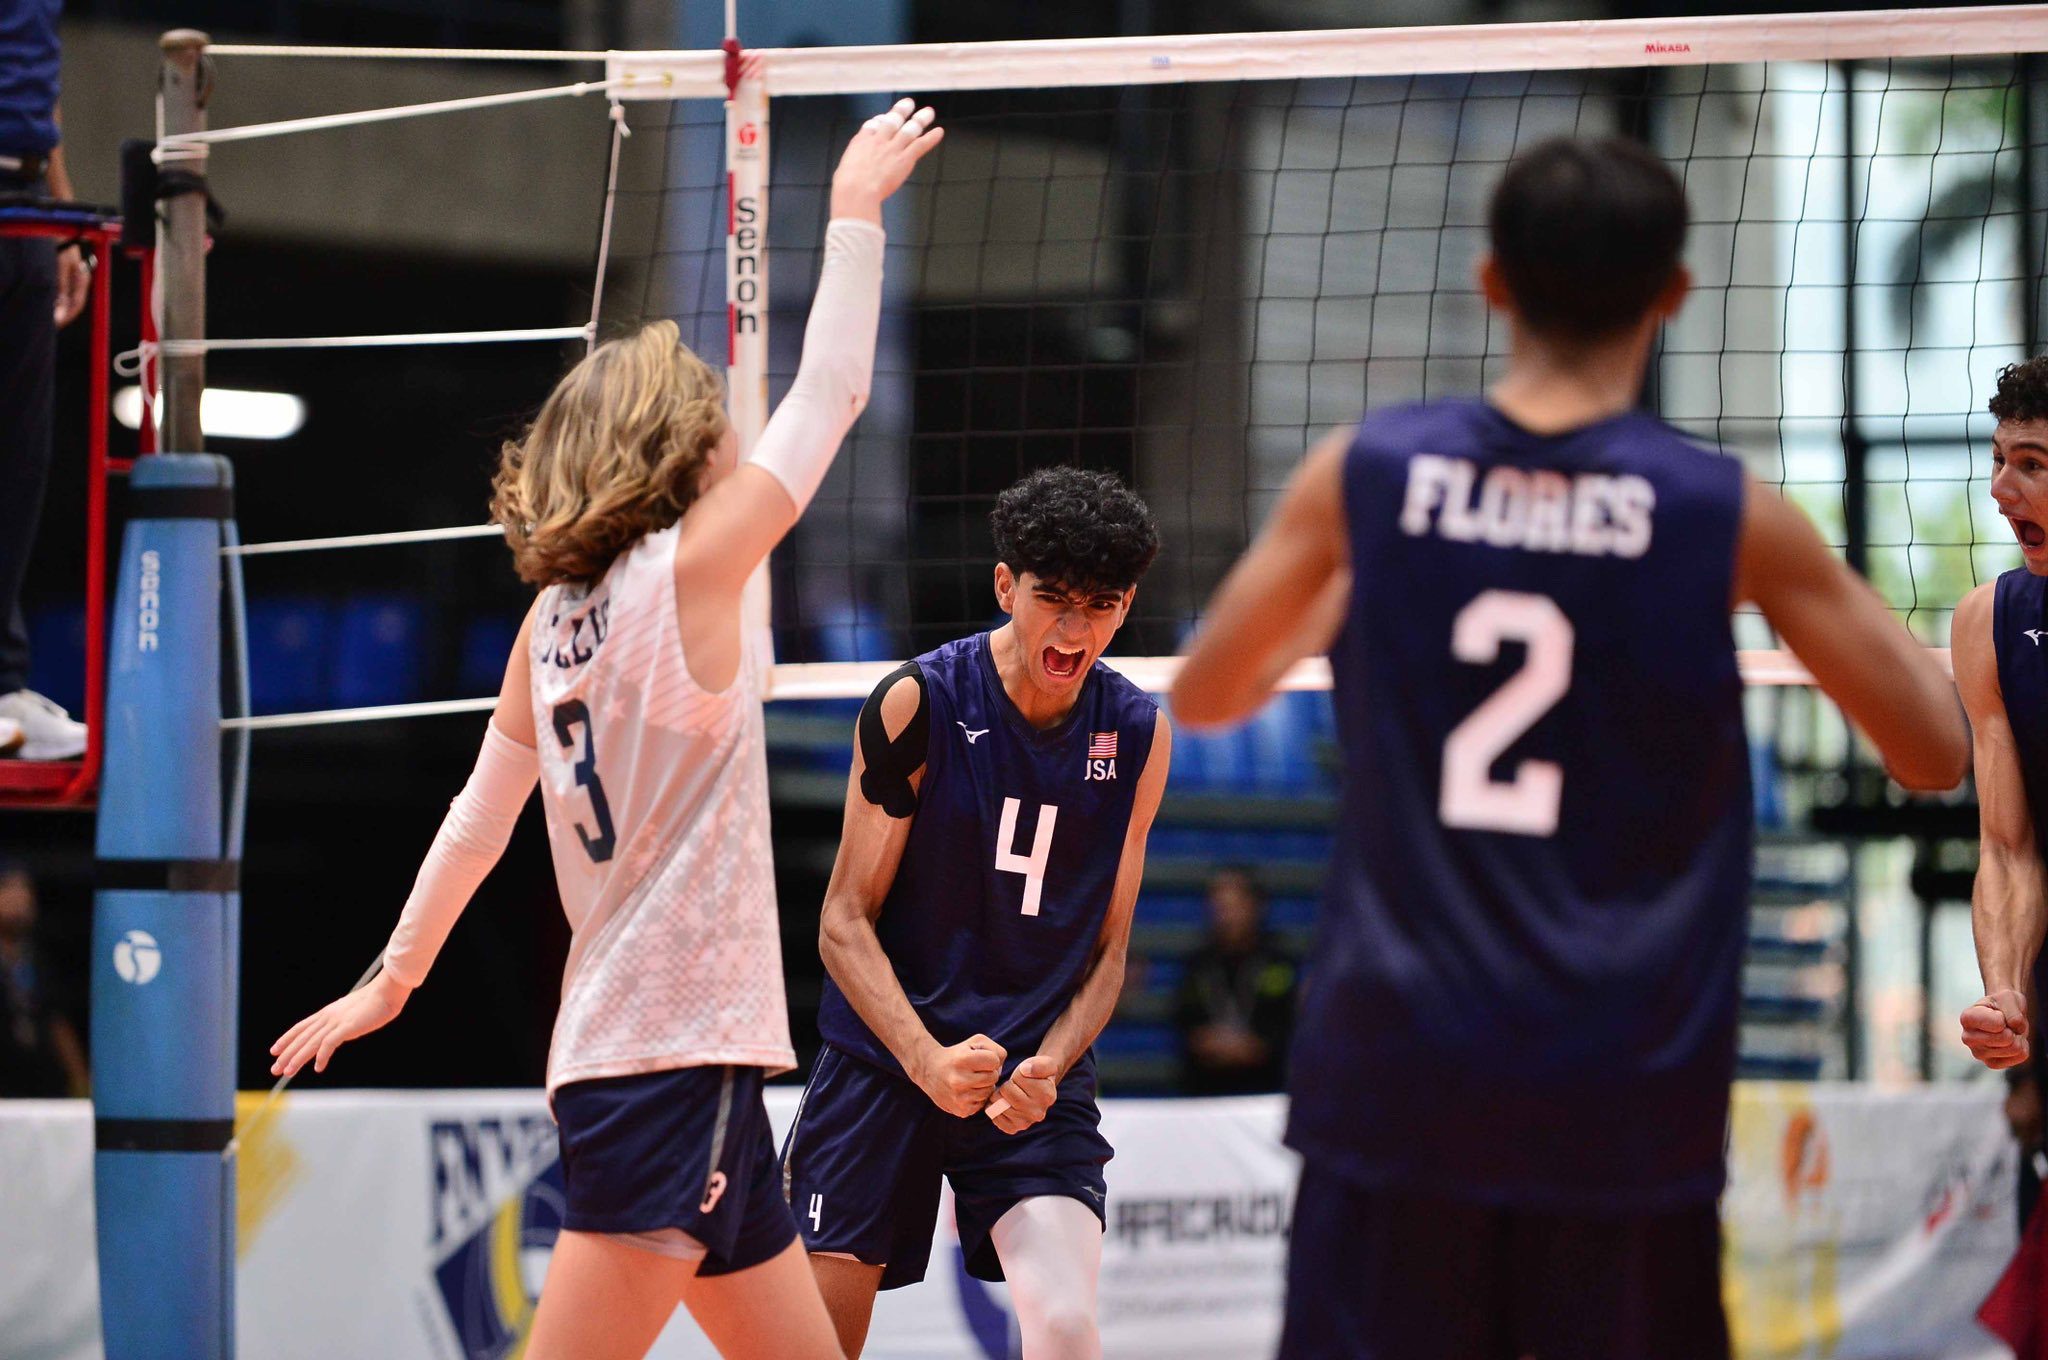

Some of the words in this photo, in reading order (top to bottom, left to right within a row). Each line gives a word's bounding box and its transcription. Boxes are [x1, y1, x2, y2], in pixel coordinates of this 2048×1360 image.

[1401, 454, 1656, 559] FLORES
[1438, 588, 1575, 838] 2
[553, 698, 616, 862] 3
[995, 797, 1058, 917] 4
[699, 1171, 727, 1213] 3
[808, 1193, 822, 1232] 4
